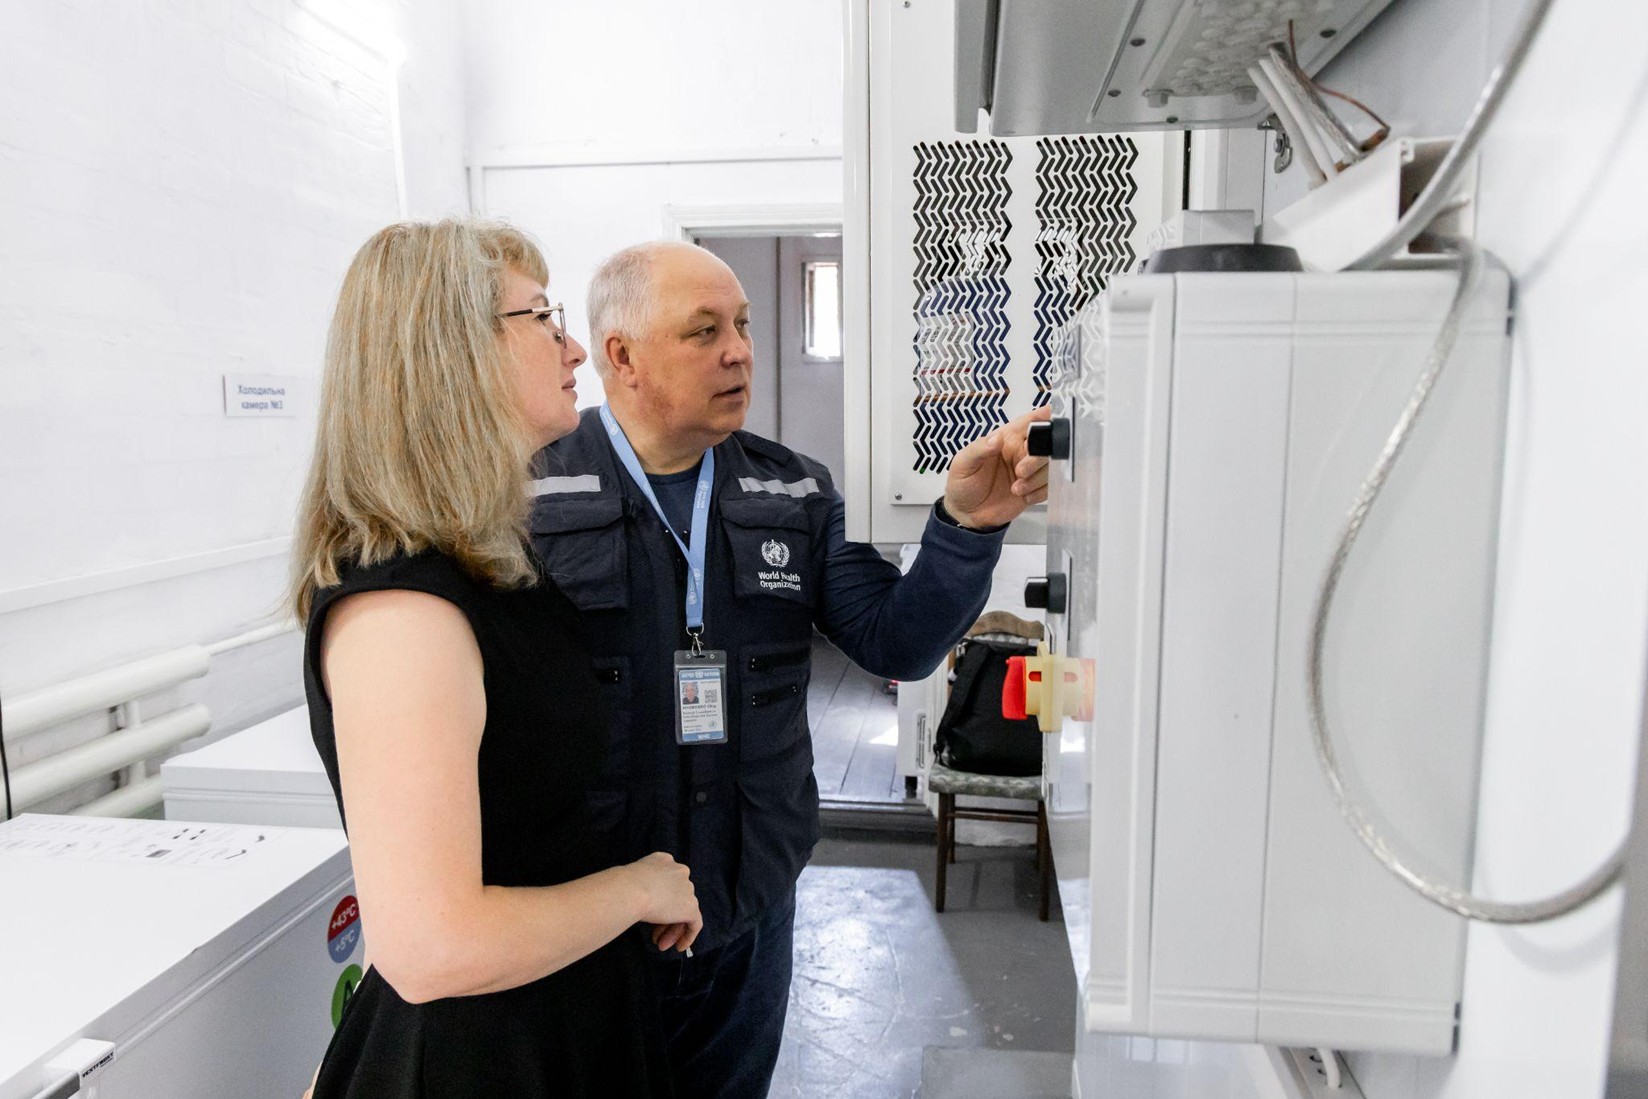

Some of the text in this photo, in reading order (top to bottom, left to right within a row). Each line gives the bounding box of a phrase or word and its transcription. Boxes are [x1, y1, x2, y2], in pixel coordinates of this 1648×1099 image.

[237, 384, 285, 396] Холодильна
[241, 401, 269, 412] камера
[757, 571, 780, 580] World
